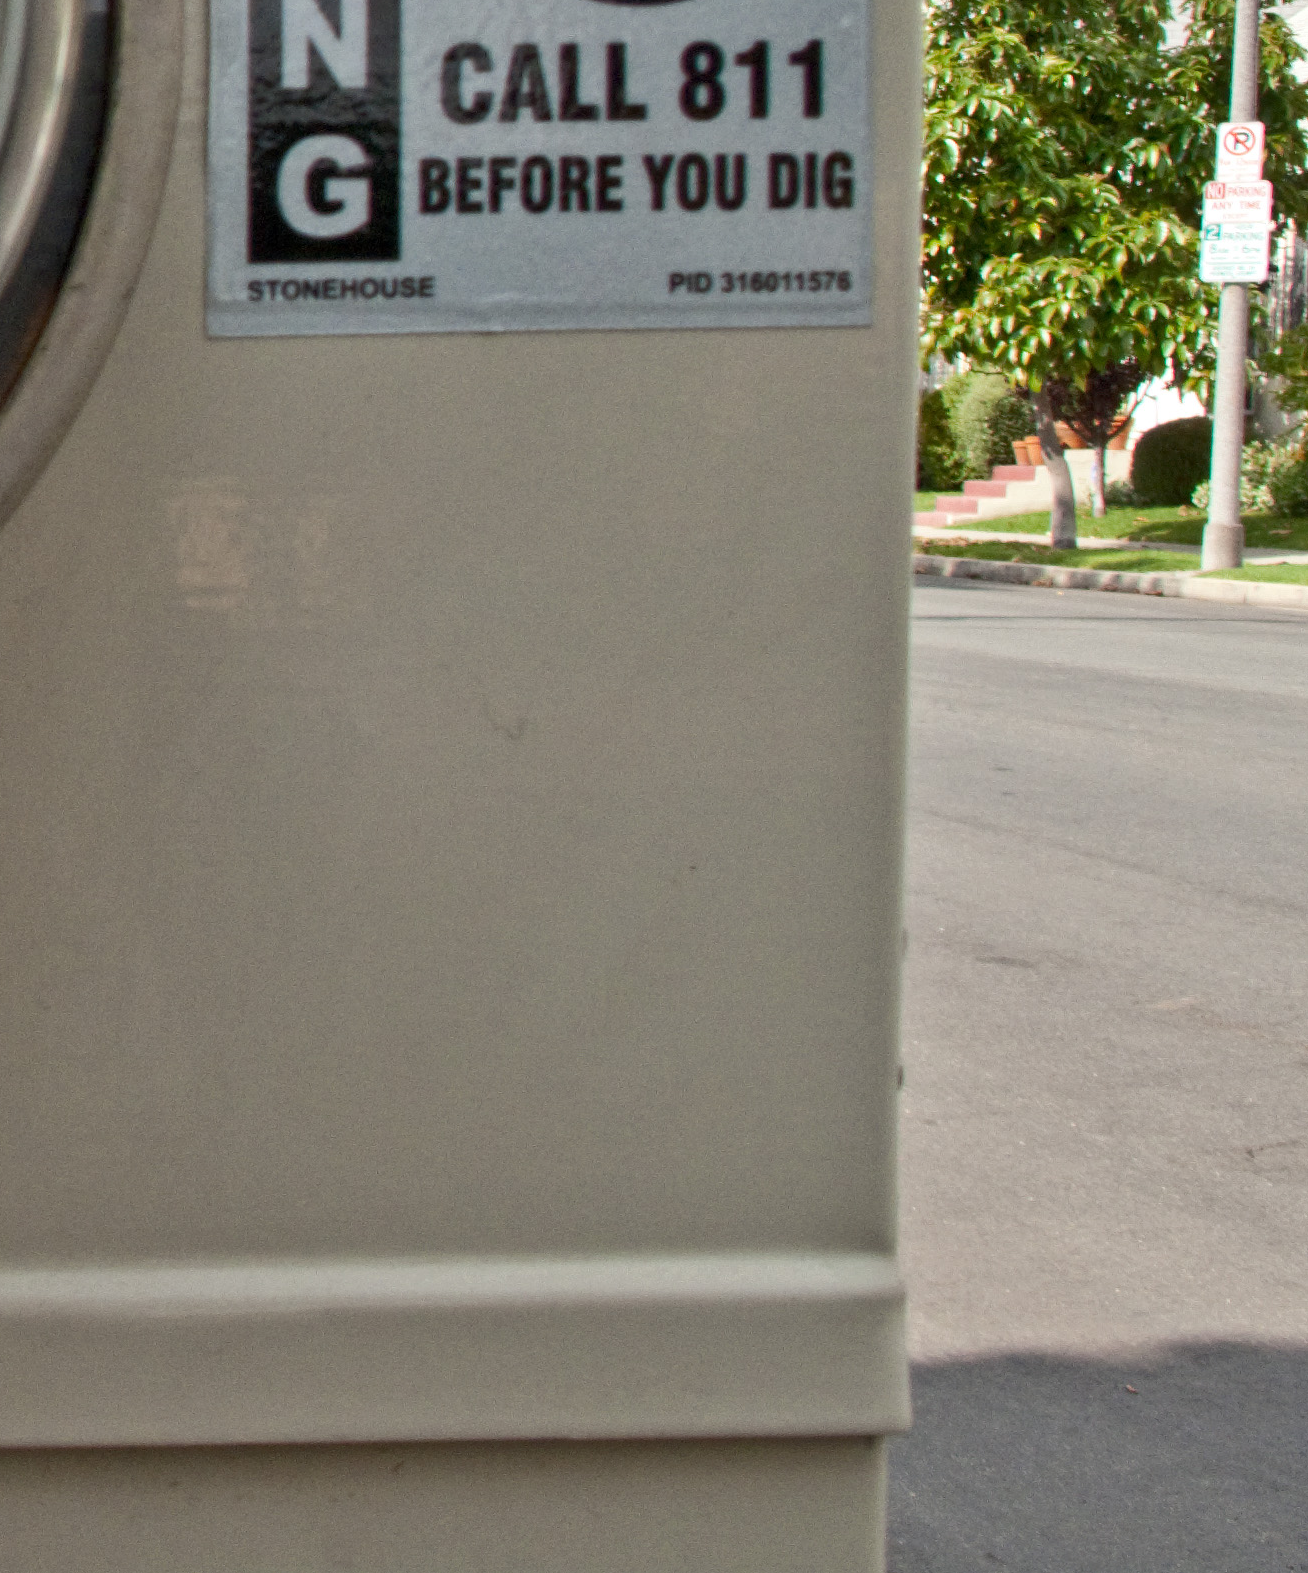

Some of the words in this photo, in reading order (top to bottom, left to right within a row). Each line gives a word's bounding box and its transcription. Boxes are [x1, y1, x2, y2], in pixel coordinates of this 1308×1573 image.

[439, 43, 647, 124] CALL
[679, 39, 825, 121] 811
[418, 155, 623, 215] BEFORE
[643, 153, 747, 211] YOU
[768, 152, 855, 209] DIG
[247, 276, 435, 301] STONEHOUSE
[669, 273, 712, 294] PID
[720, 272, 851, 294] 316011576
